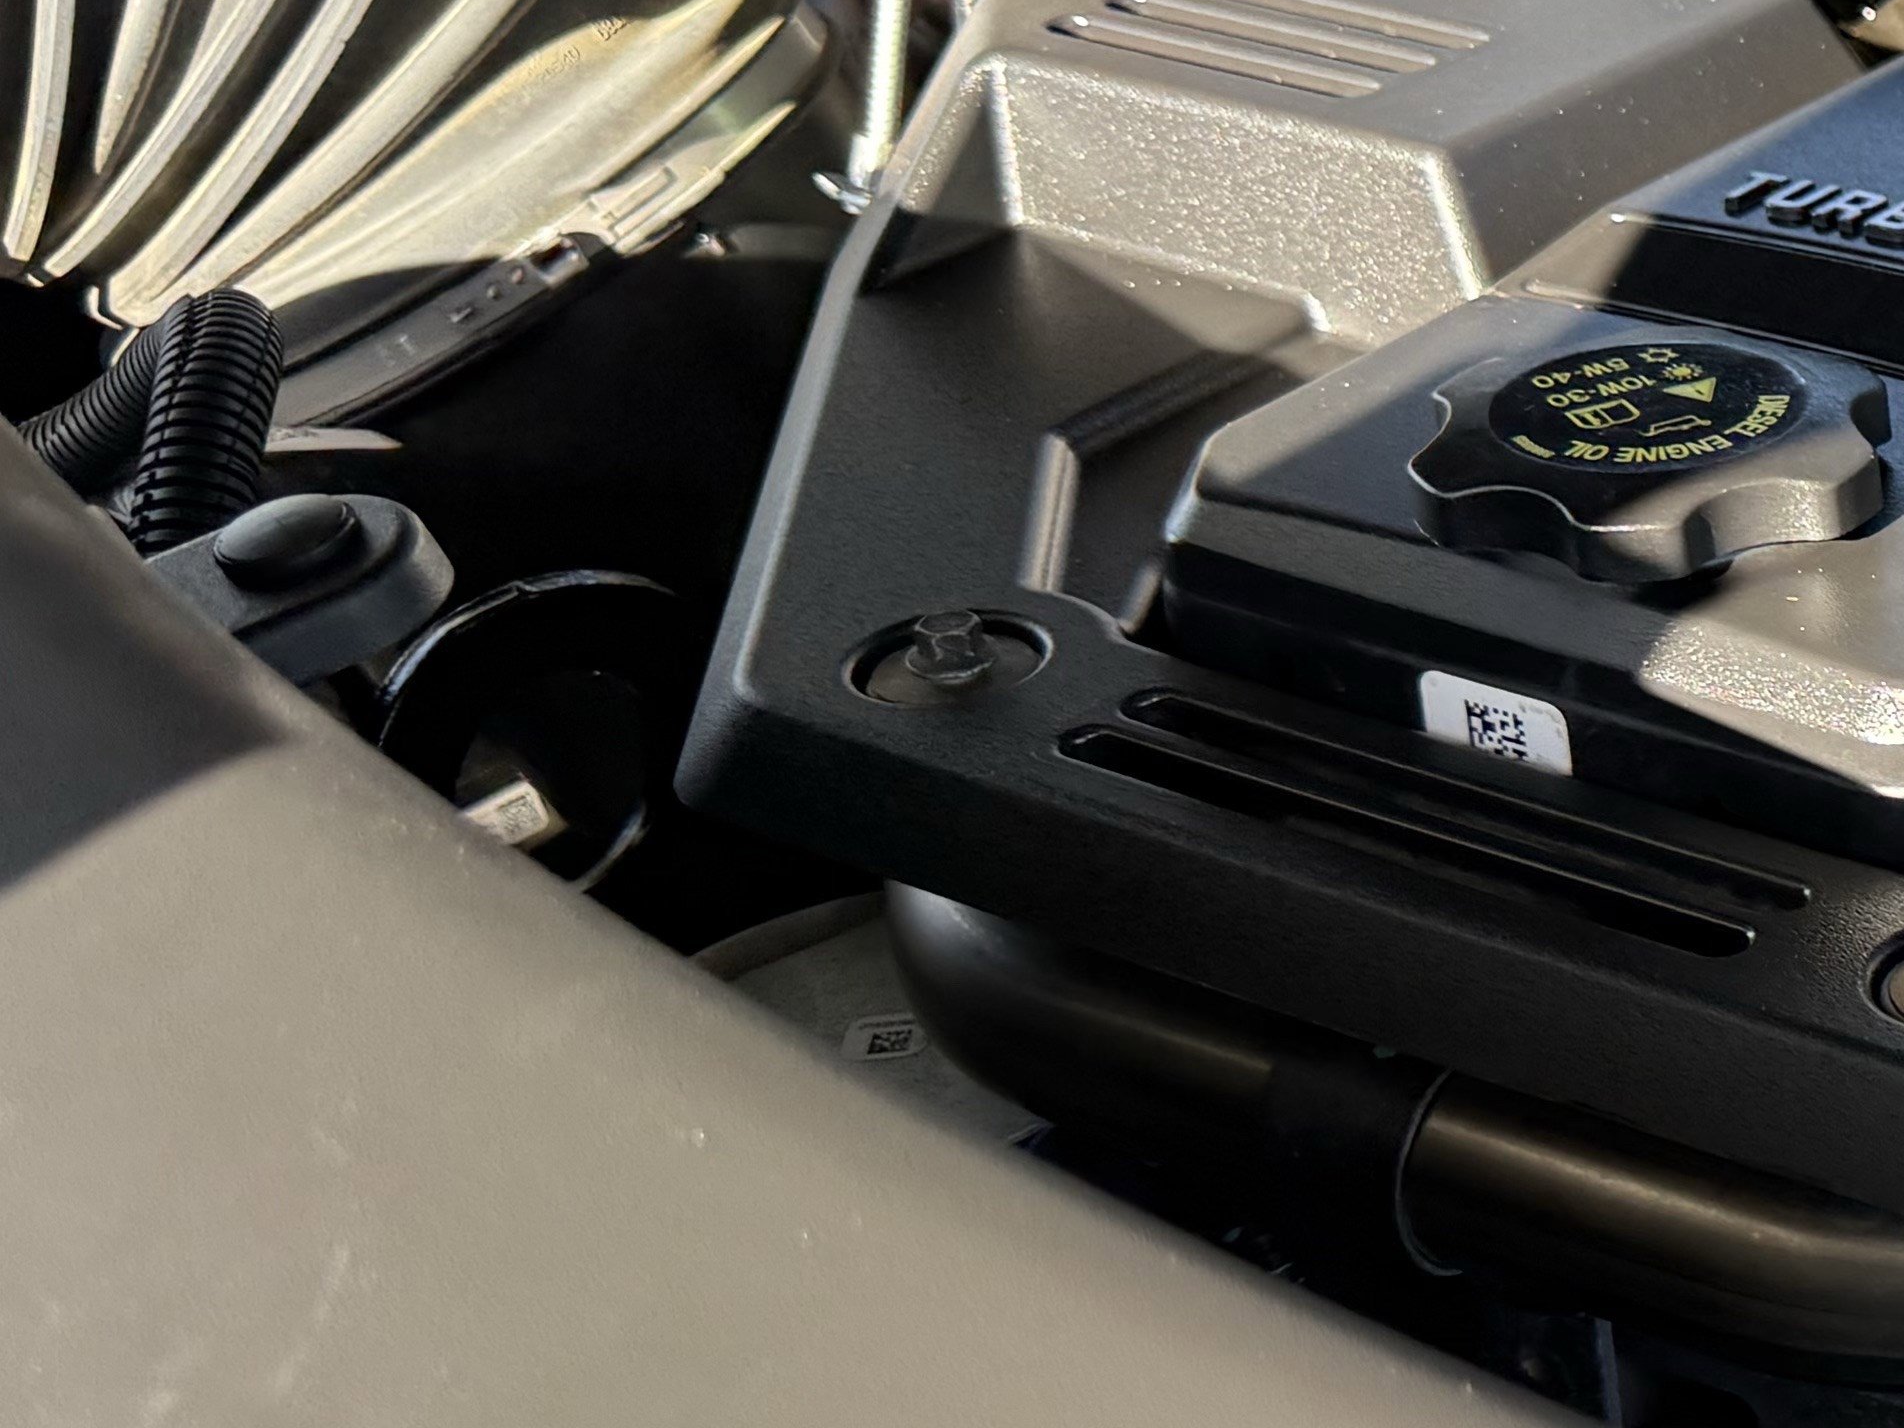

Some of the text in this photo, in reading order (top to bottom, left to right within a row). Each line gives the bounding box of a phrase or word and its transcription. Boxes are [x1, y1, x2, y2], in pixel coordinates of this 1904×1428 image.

[1531, 357, 1631, 390] 5W-40
[1546, 374, 1658, 408] 10W-30
[1724, 394, 1791, 438] DIESEL
[1563, 439, 1611, 462] OIL
[1613, 434, 1735, 463] ENGINE
